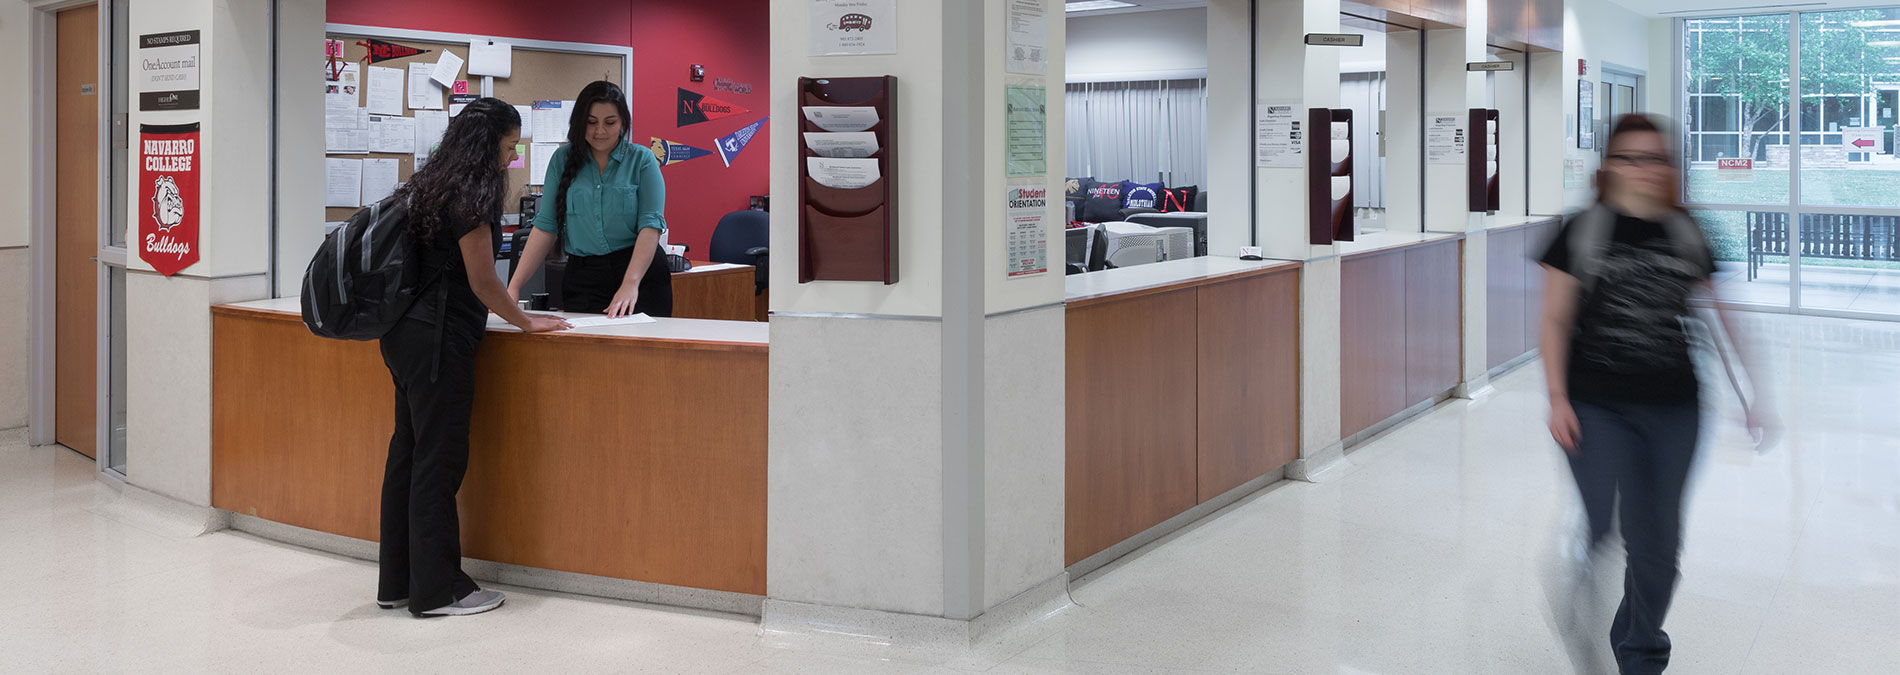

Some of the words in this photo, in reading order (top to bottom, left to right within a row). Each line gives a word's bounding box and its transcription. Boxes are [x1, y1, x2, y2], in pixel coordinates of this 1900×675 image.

[169, 34, 191, 43] REQUIRED
[142, 58, 180, 71] OneAccount
[181, 55, 196, 68] mail
[683, 100, 694, 114] N
[702, 103, 731, 114] BULLDOGS
[144, 139, 194, 155] NAVARRO
[145, 156, 192, 172] COLLEGE
[1019, 188, 1046, 199] Student
[1087, 187, 1120, 196] NINETEEN
[1009, 200, 1046, 208] ORIENTATION
[1160, 189, 1190, 212] N
[146, 233, 190, 260] Bulldogs
